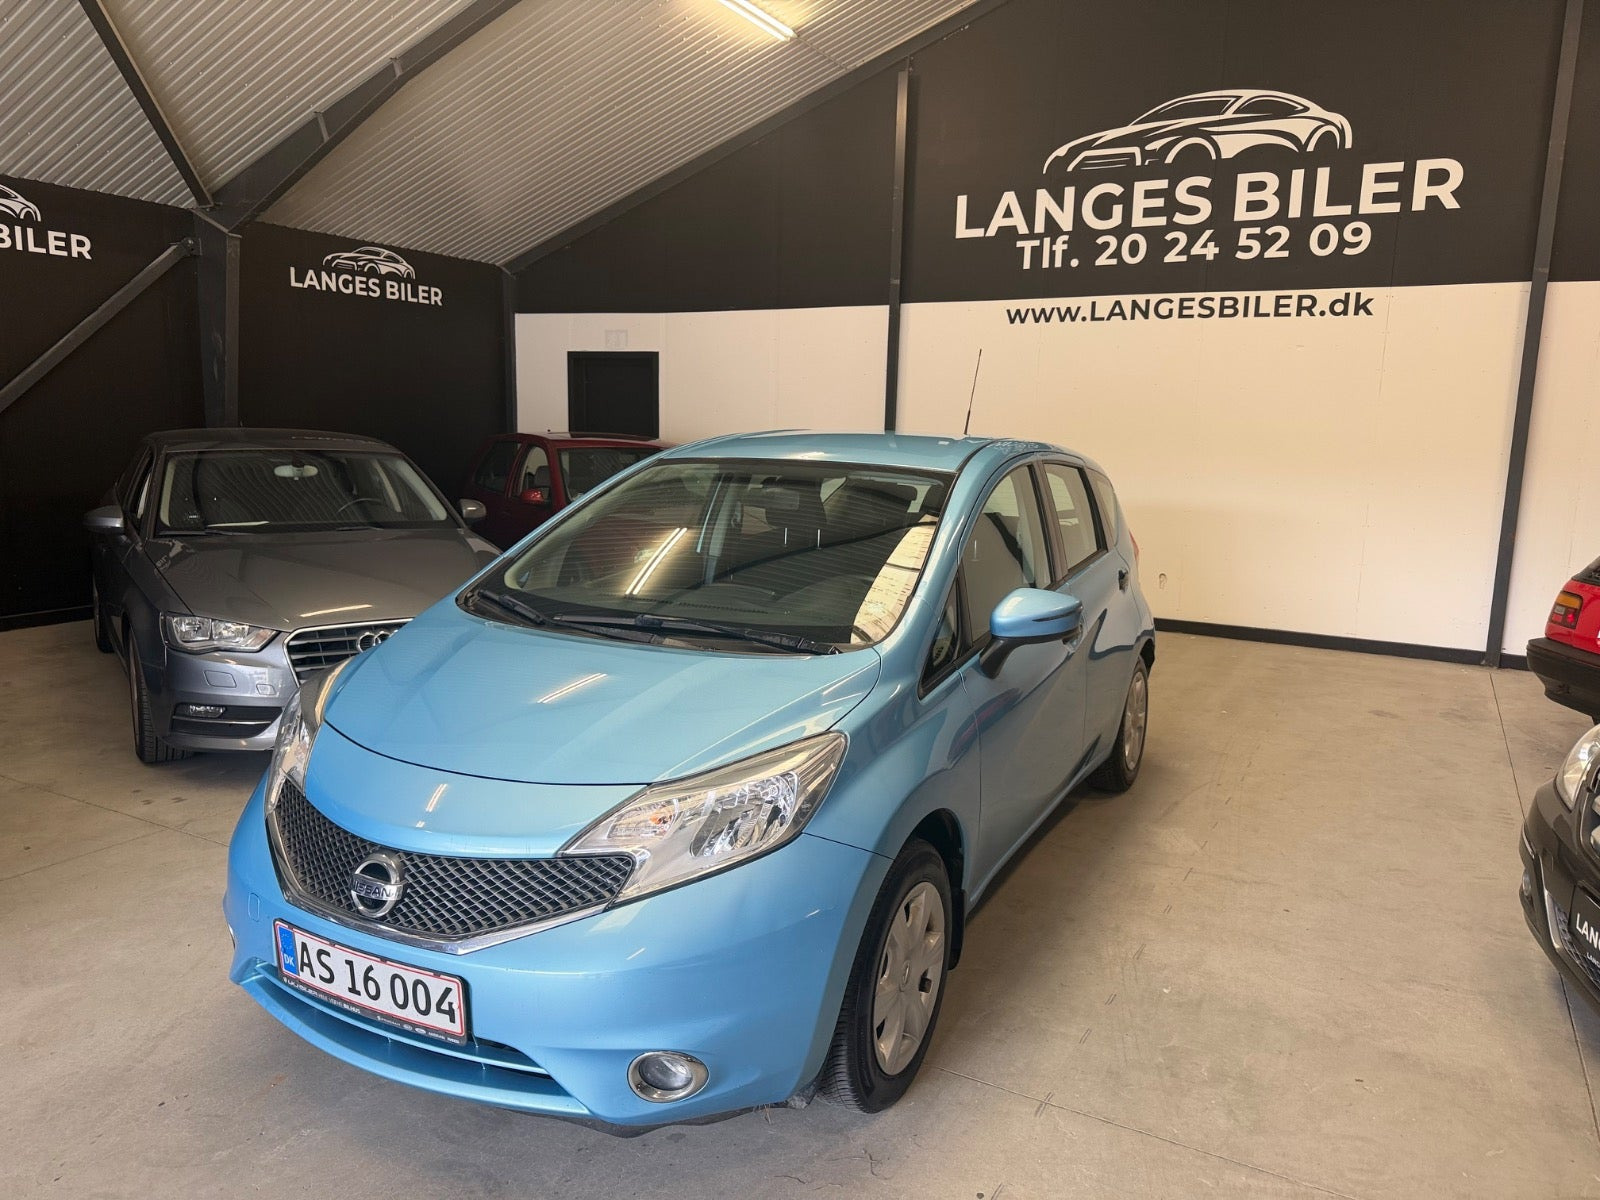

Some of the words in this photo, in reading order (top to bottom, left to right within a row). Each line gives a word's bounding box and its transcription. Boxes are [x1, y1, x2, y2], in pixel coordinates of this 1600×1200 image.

[955, 176, 1213, 239] LANGES
[1233, 158, 1464, 222] BILER
[1016, 234, 1079, 270] Tlf.
[1095, 233, 1147, 266] 20
[1164, 229, 1220, 263] 24
[1235, 225, 1290, 260] 52
[1309, 221, 1372, 256] 09
[289, 266, 381, 298] LANGES
[386, 280, 443, 306] BILER
[1006, 292, 1375, 325] www.LANGESBILER.dk
[353, 879, 391, 898] ISSAN
[1576, 912, 1600, 951] LAN
[283, 953, 295, 967] DK
[300, 941, 335, 984] AS
[345, 959, 381, 1001] 16
[390, 973, 456, 1024] 004
